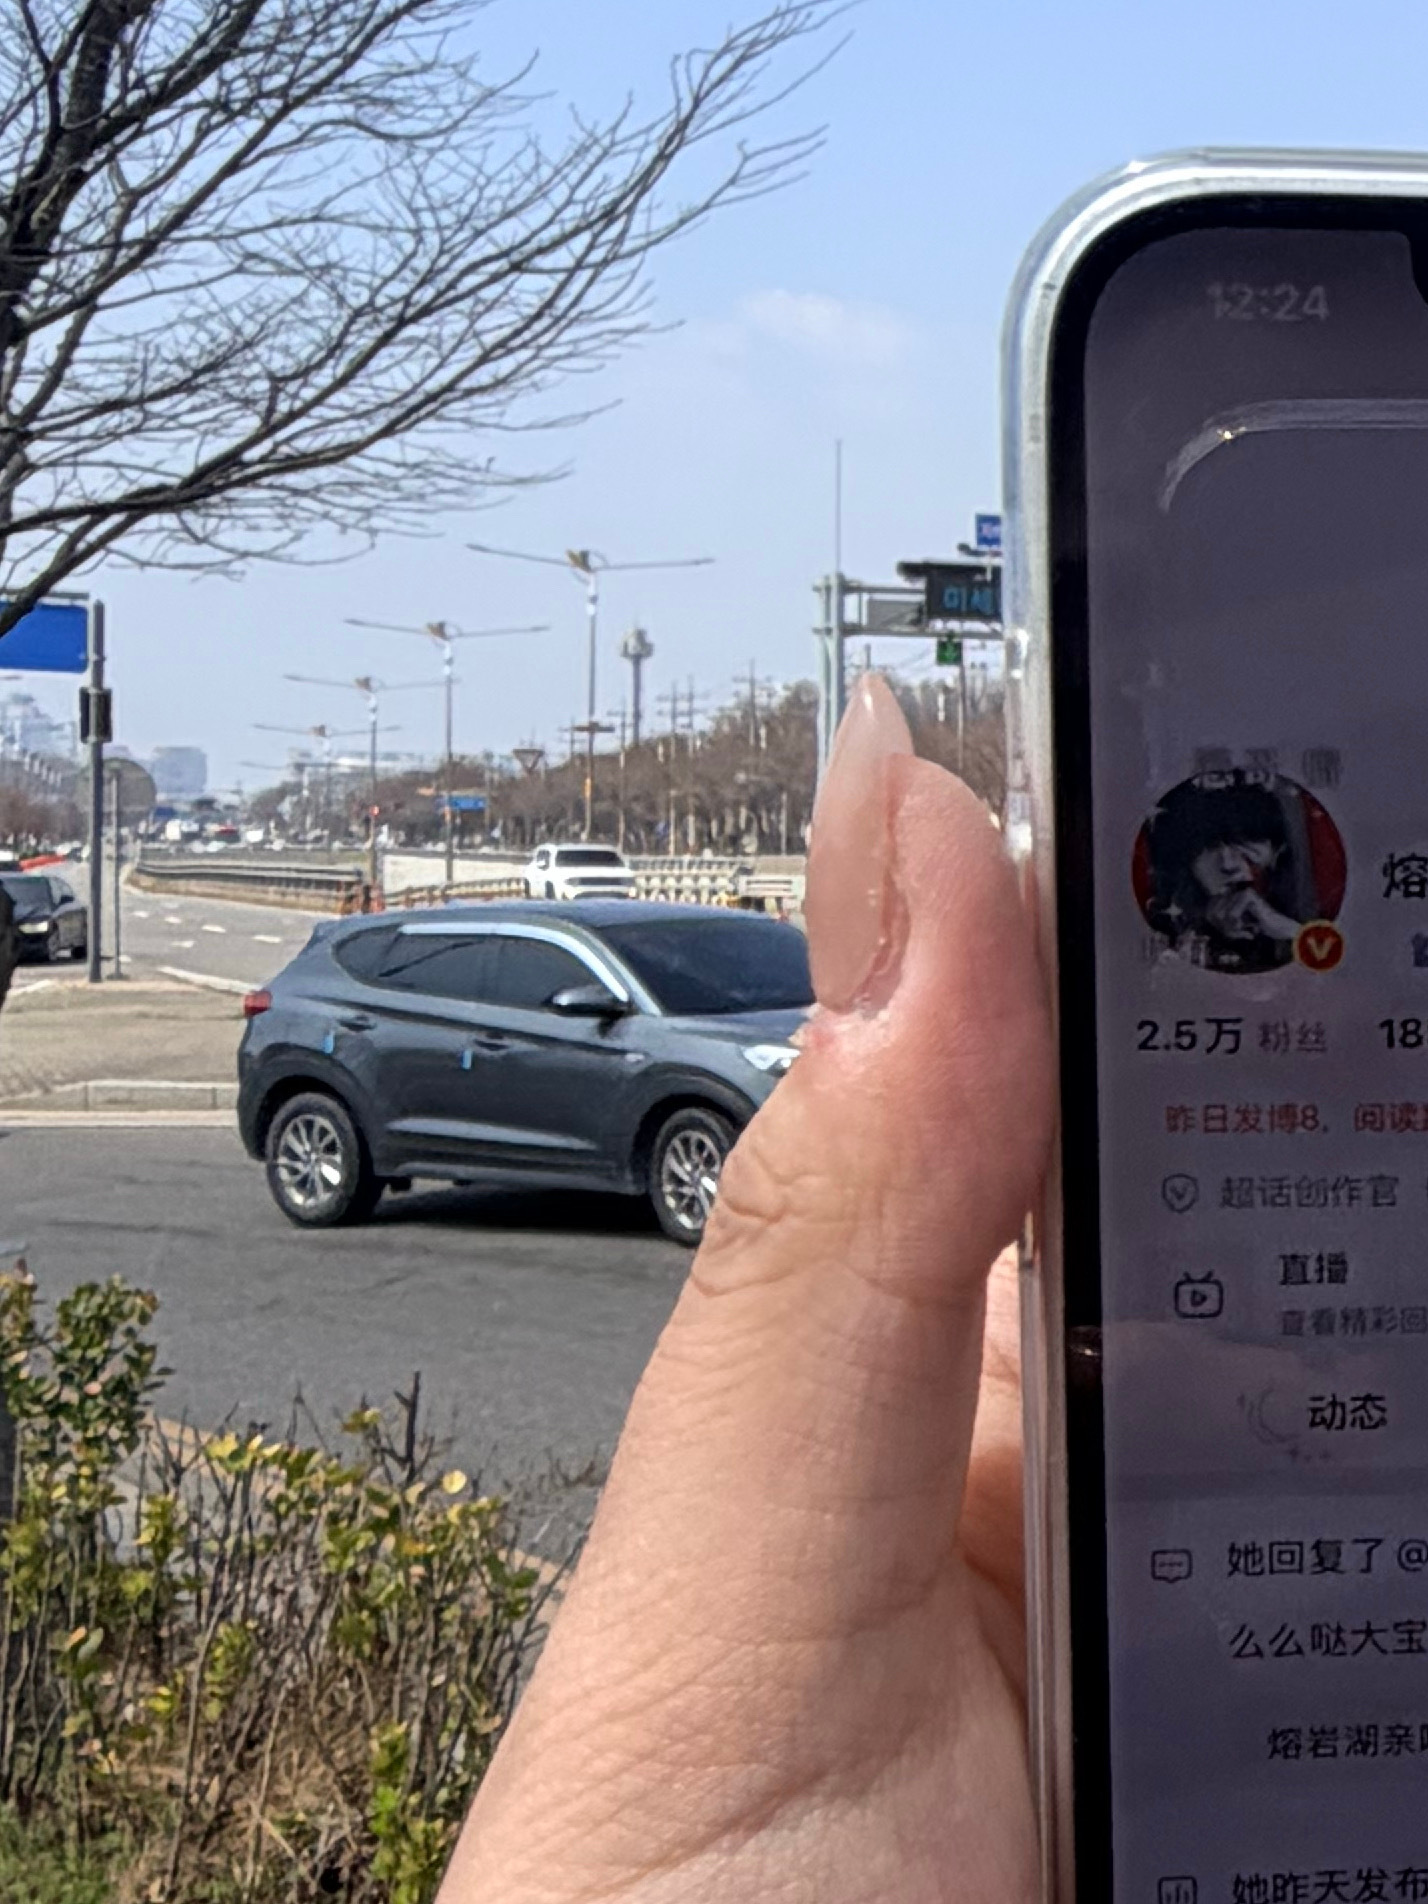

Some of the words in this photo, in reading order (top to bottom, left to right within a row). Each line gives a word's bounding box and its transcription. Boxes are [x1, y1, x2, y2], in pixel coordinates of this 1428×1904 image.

[1206, 282, 1329, 322] 12:24
[1136, 1016, 1244, 1055] 2.5万
[1257, 1022, 1327, 1056] 粉丝
[1280, 1250, 1350, 1286] 直播
[1307, 1393, 1389, 1432] 动态
[1228, 1618, 1428, 1662] 么么哒大宝
